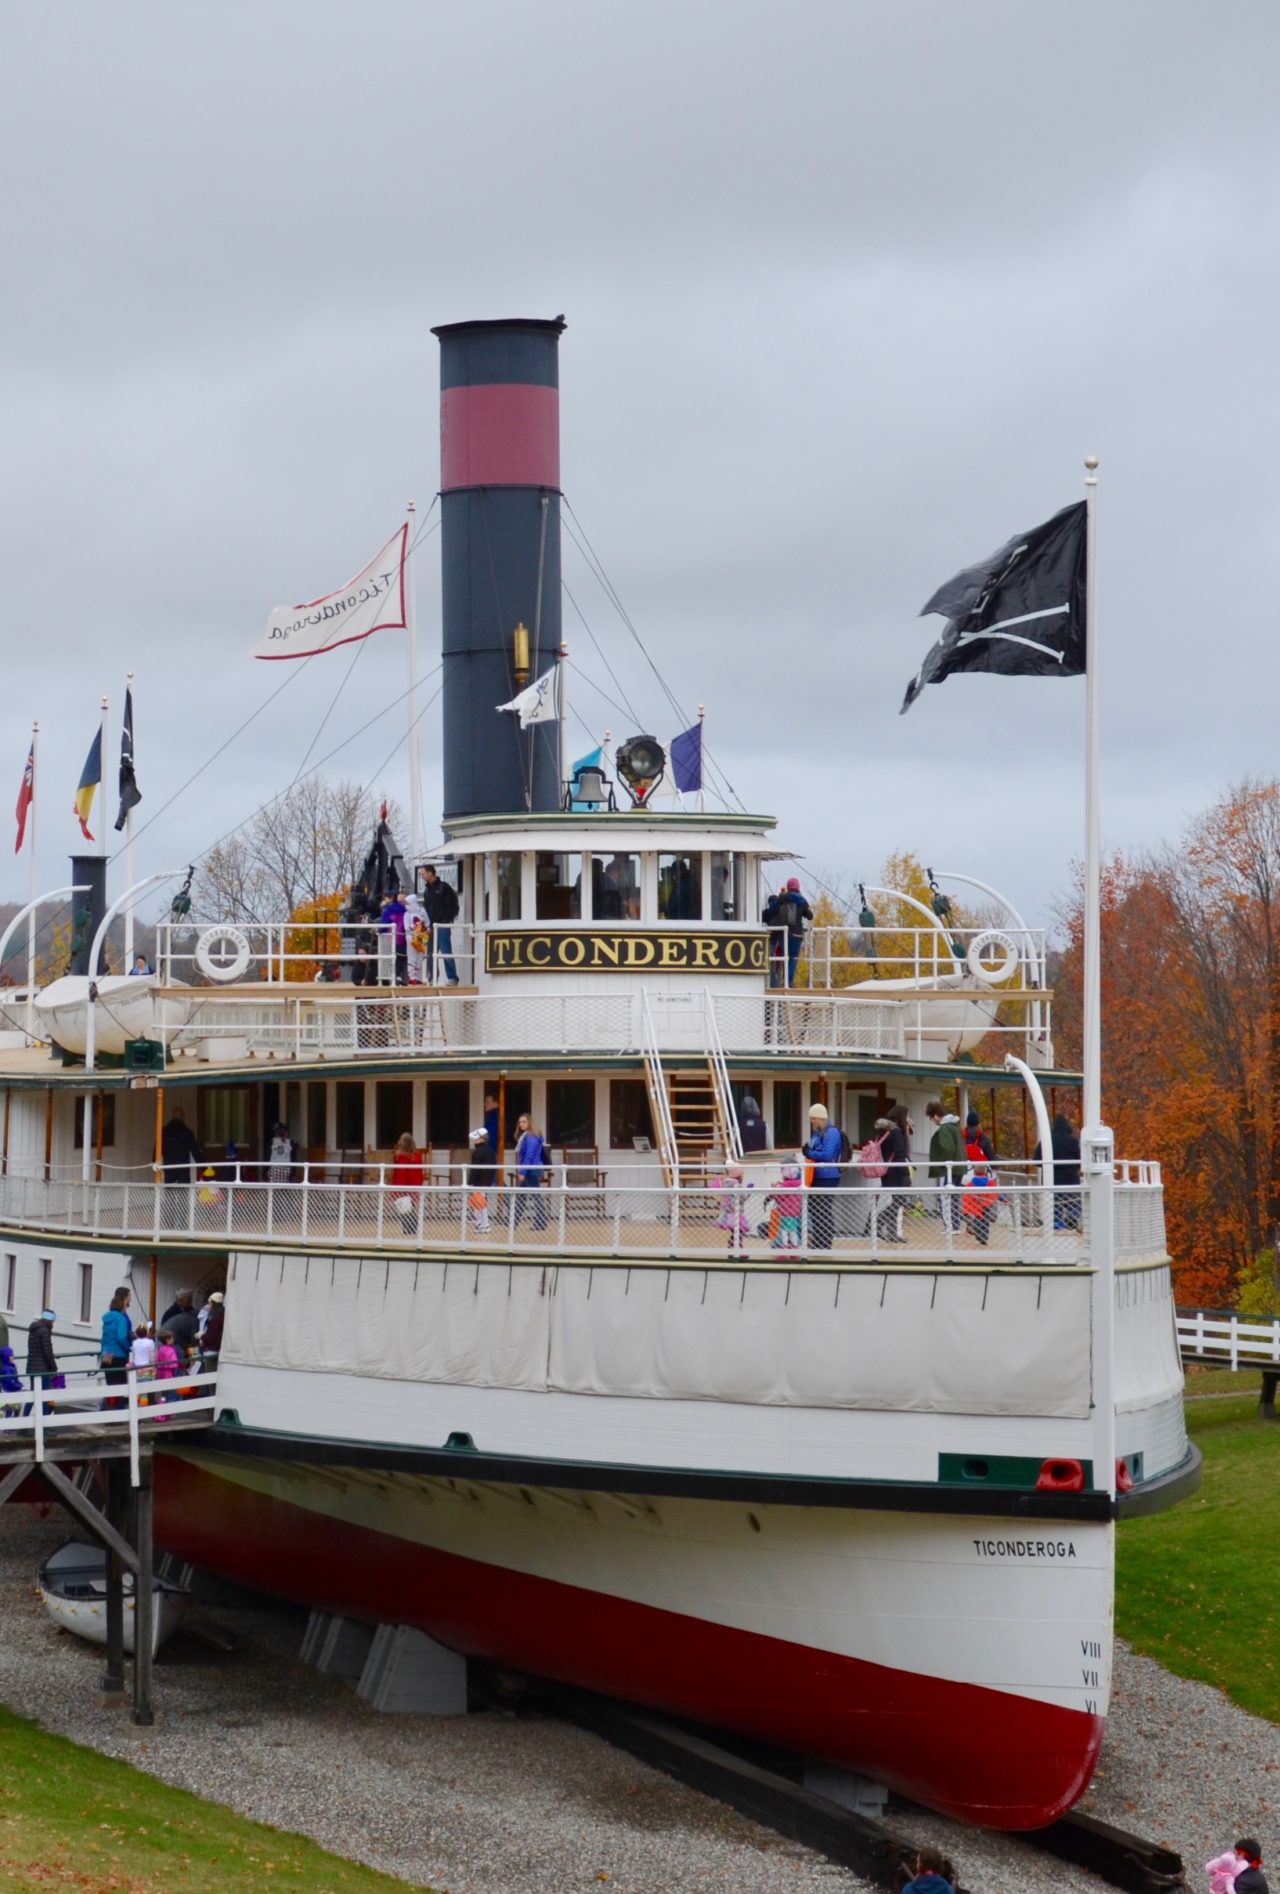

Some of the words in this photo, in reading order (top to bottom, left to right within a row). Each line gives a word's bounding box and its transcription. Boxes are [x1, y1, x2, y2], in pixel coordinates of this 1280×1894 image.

[493, 937, 768, 967] TICONDEROG
[973, 1540, 1076, 1558] TICONDEROGA
[1081, 1640, 1101, 1659] VIII
[1082, 1669, 1099, 1687] VII
